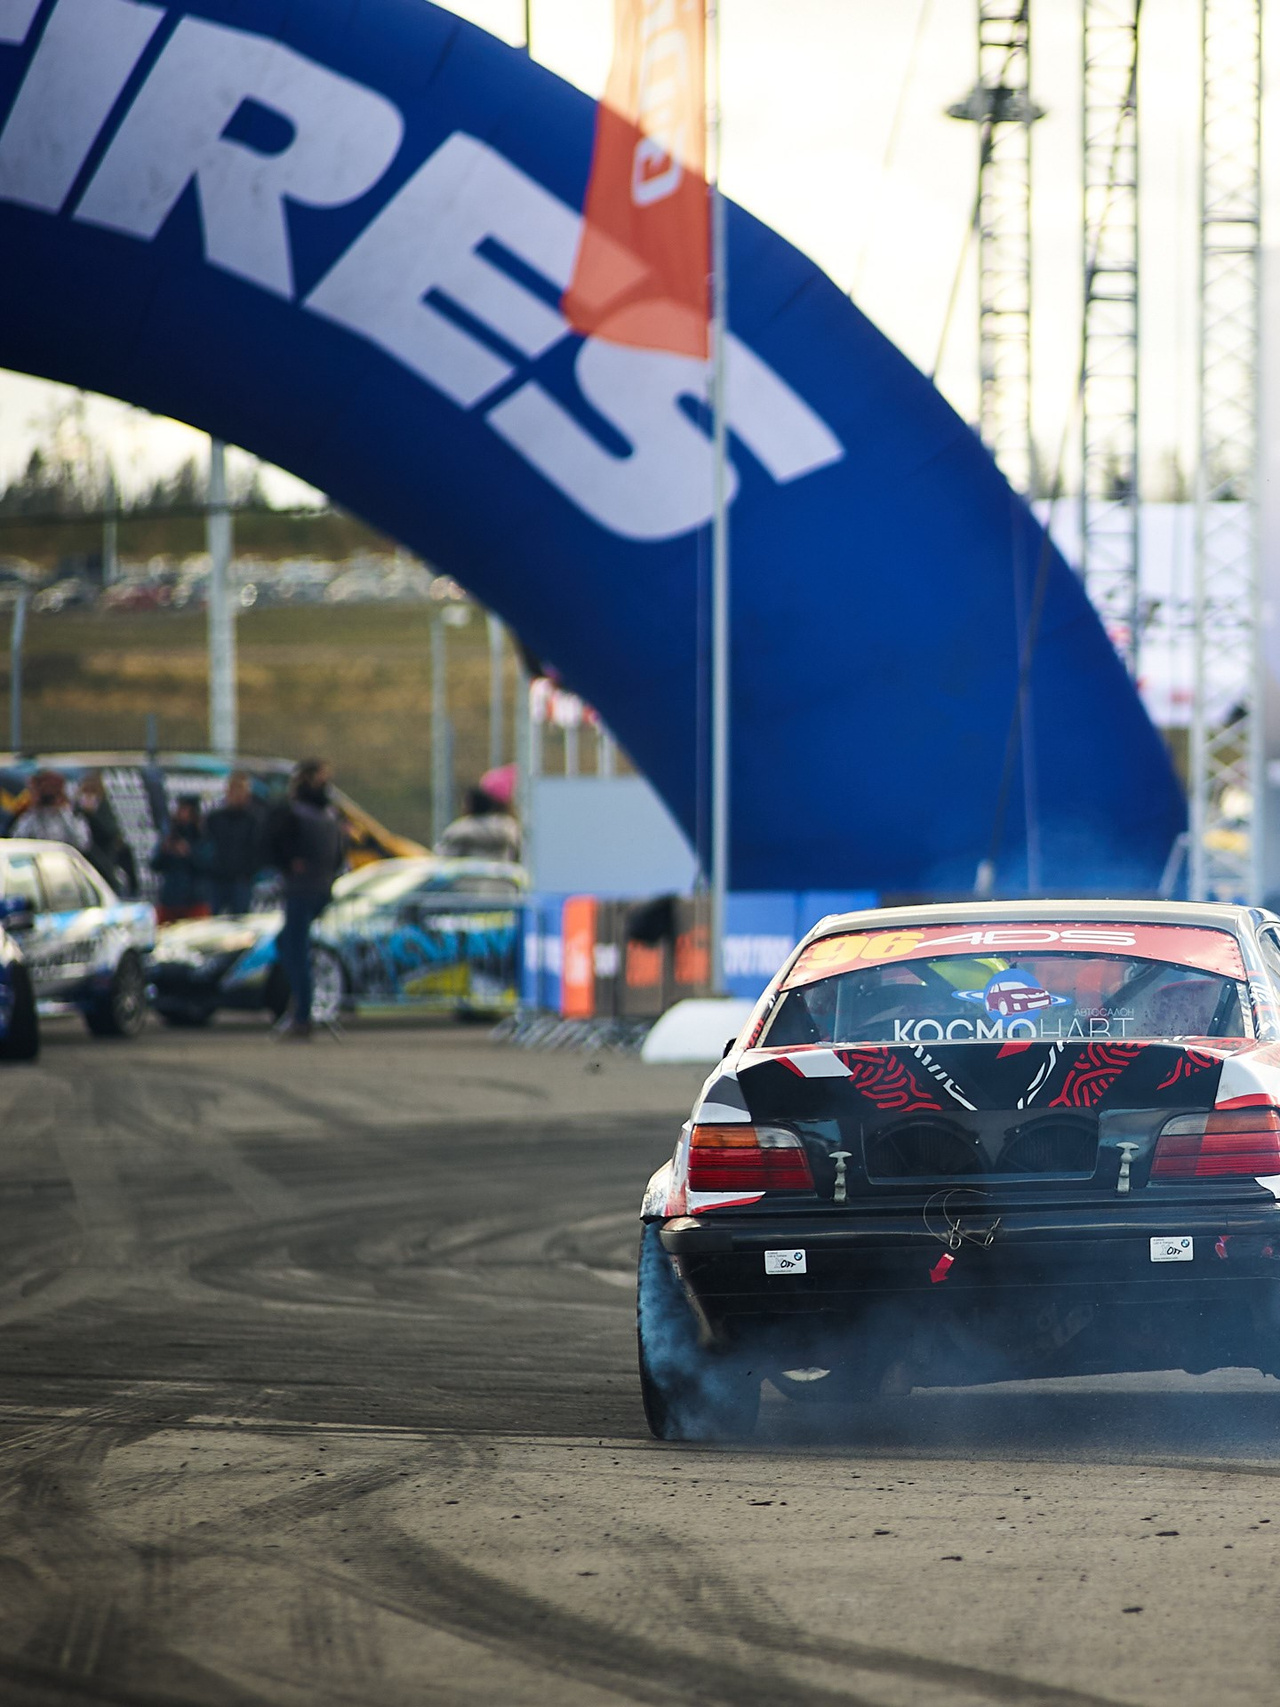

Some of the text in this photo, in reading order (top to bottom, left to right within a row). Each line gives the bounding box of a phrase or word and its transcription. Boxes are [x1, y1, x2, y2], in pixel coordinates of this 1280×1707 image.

[0, 0, 845, 542] IRES
[804, 931, 925, 971] 96
[1074, 1007, 1134, 1017] АВТОСАЛОН
